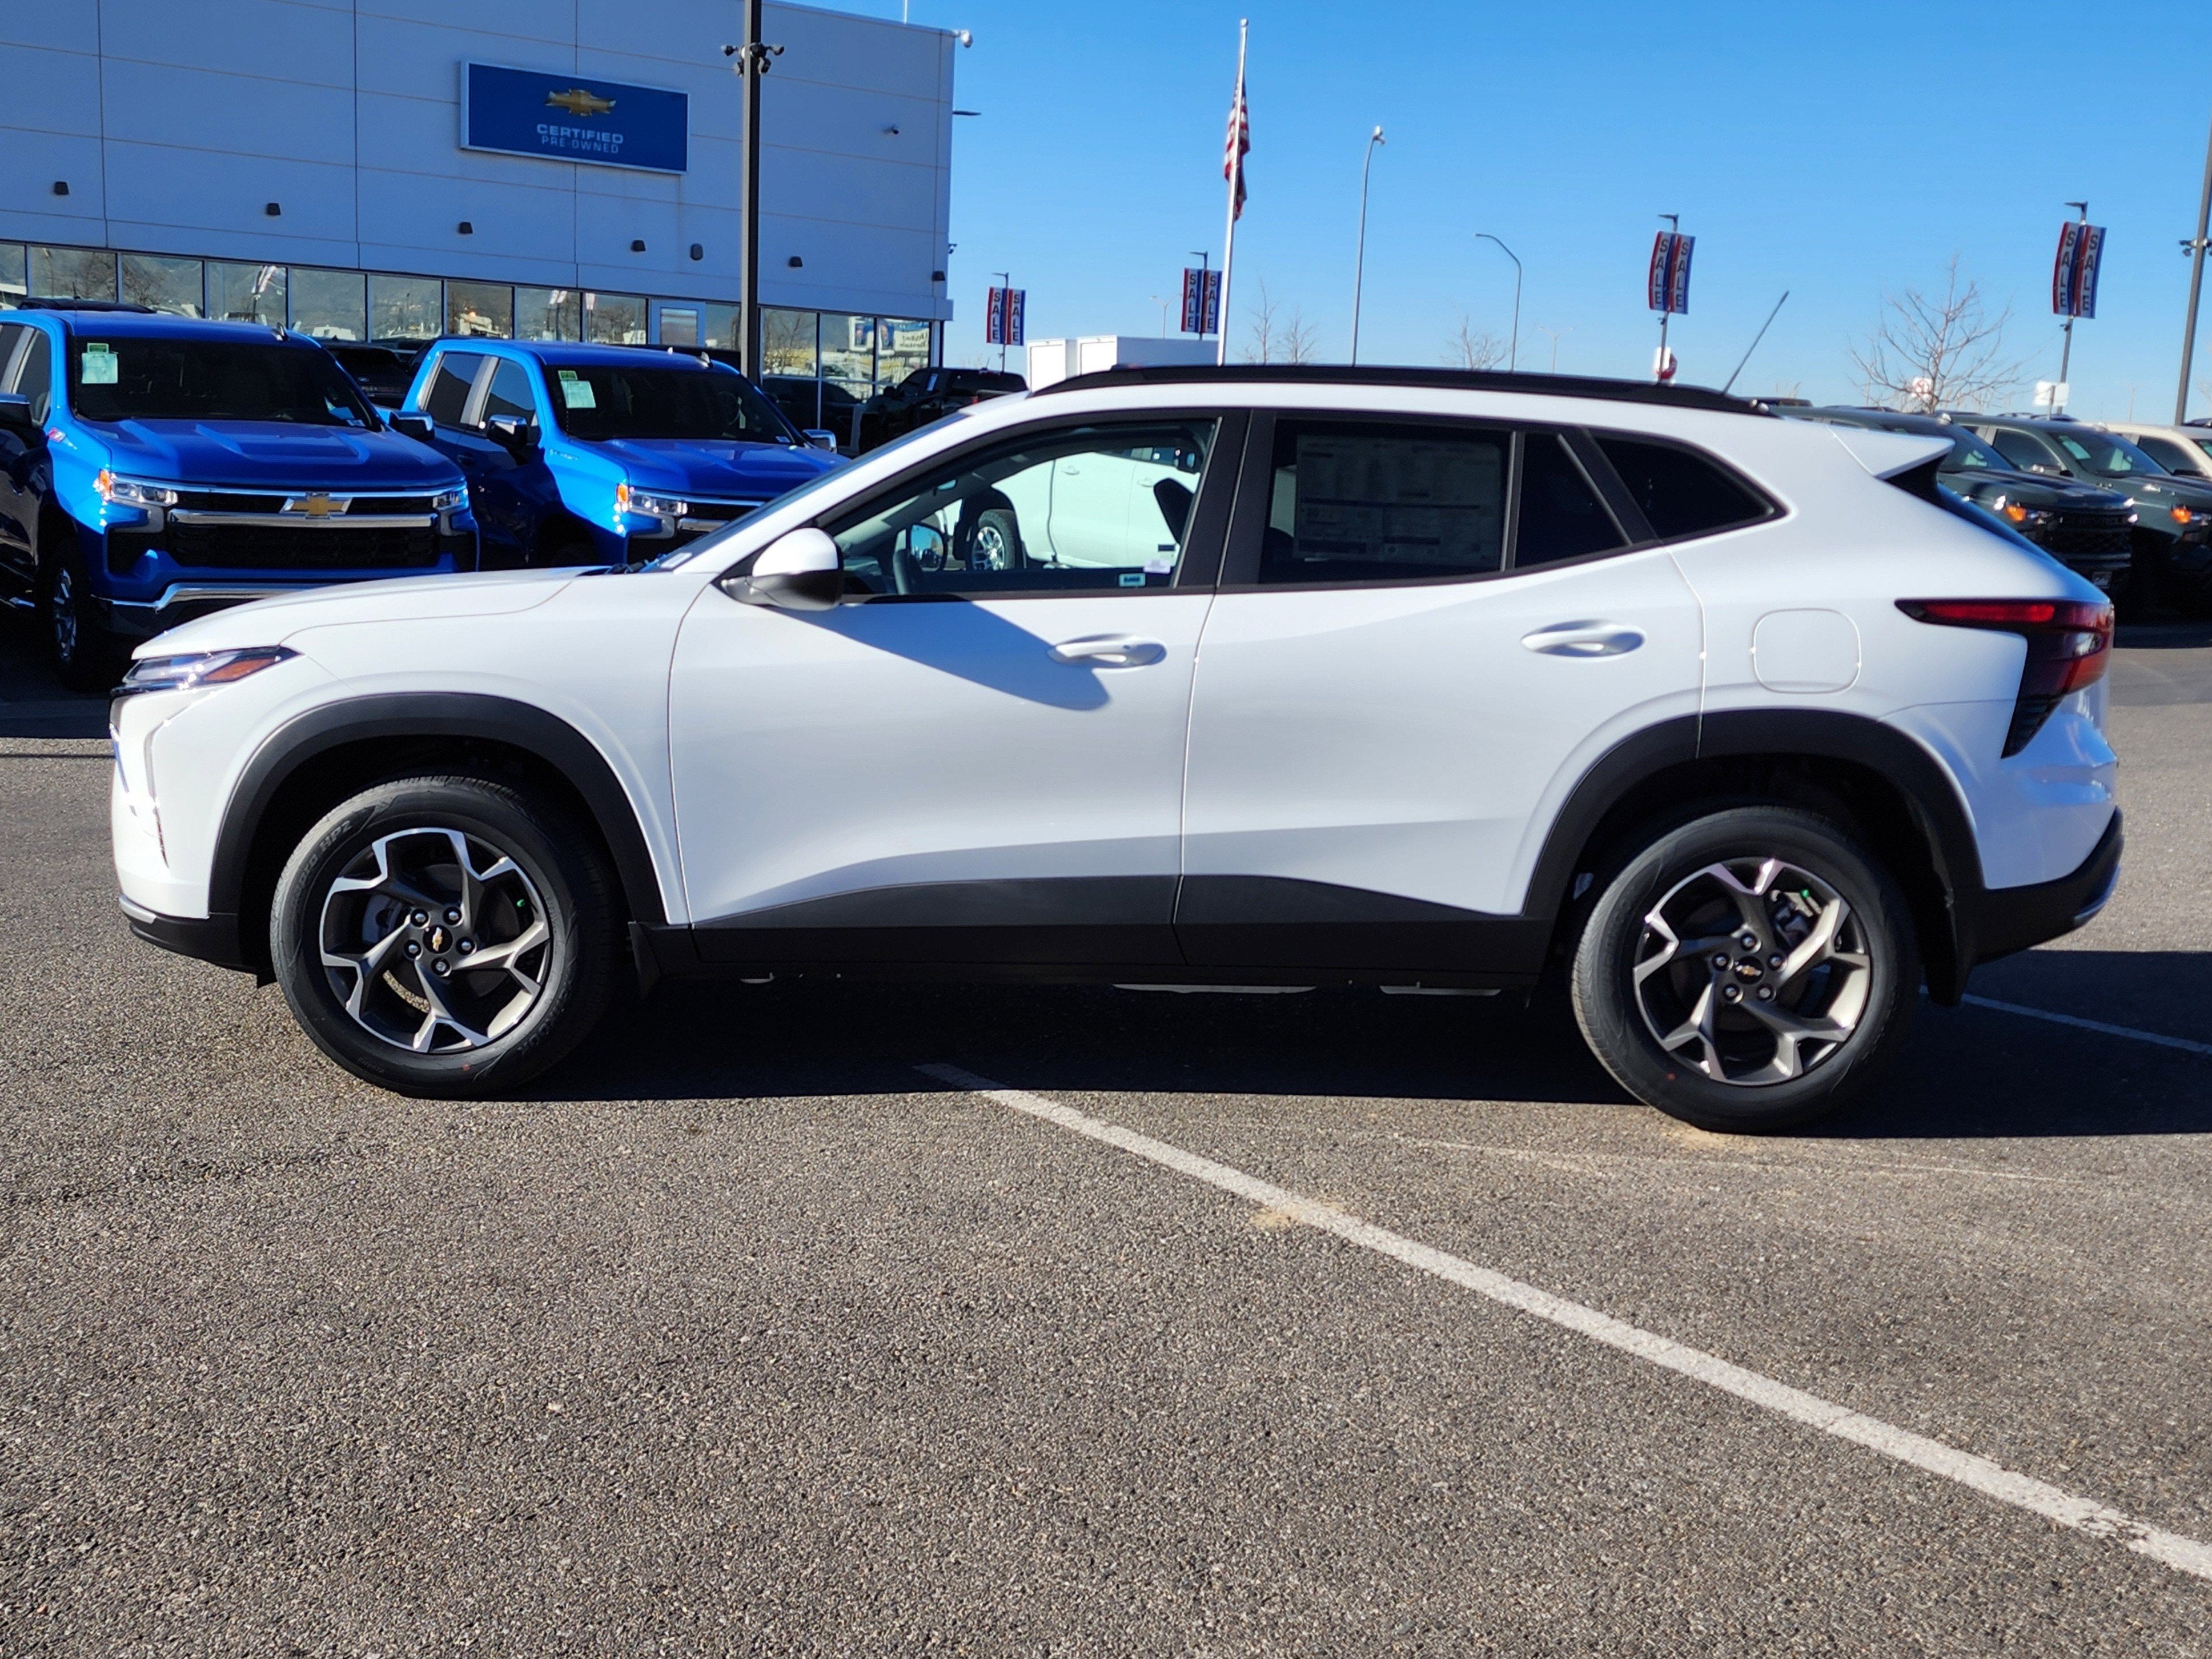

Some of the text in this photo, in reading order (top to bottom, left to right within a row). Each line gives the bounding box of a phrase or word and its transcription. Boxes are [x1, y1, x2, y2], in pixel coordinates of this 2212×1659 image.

[537, 123, 624, 144] CERTIFIED
[542, 135, 619, 154] PRE-OWNED
[1655, 238, 1668, 304] SALE
[1676, 242, 1688, 307] SALE
[2060, 231, 2075, 307] SALE
[2082, 234, 2098, 311] SALE
[992, 292, 1001, 339] SALE
[1187, 274, 1196, 327] SALE
[1207, 276, 1217, 328] SALE
[319, 820, 352, 853] HP2
